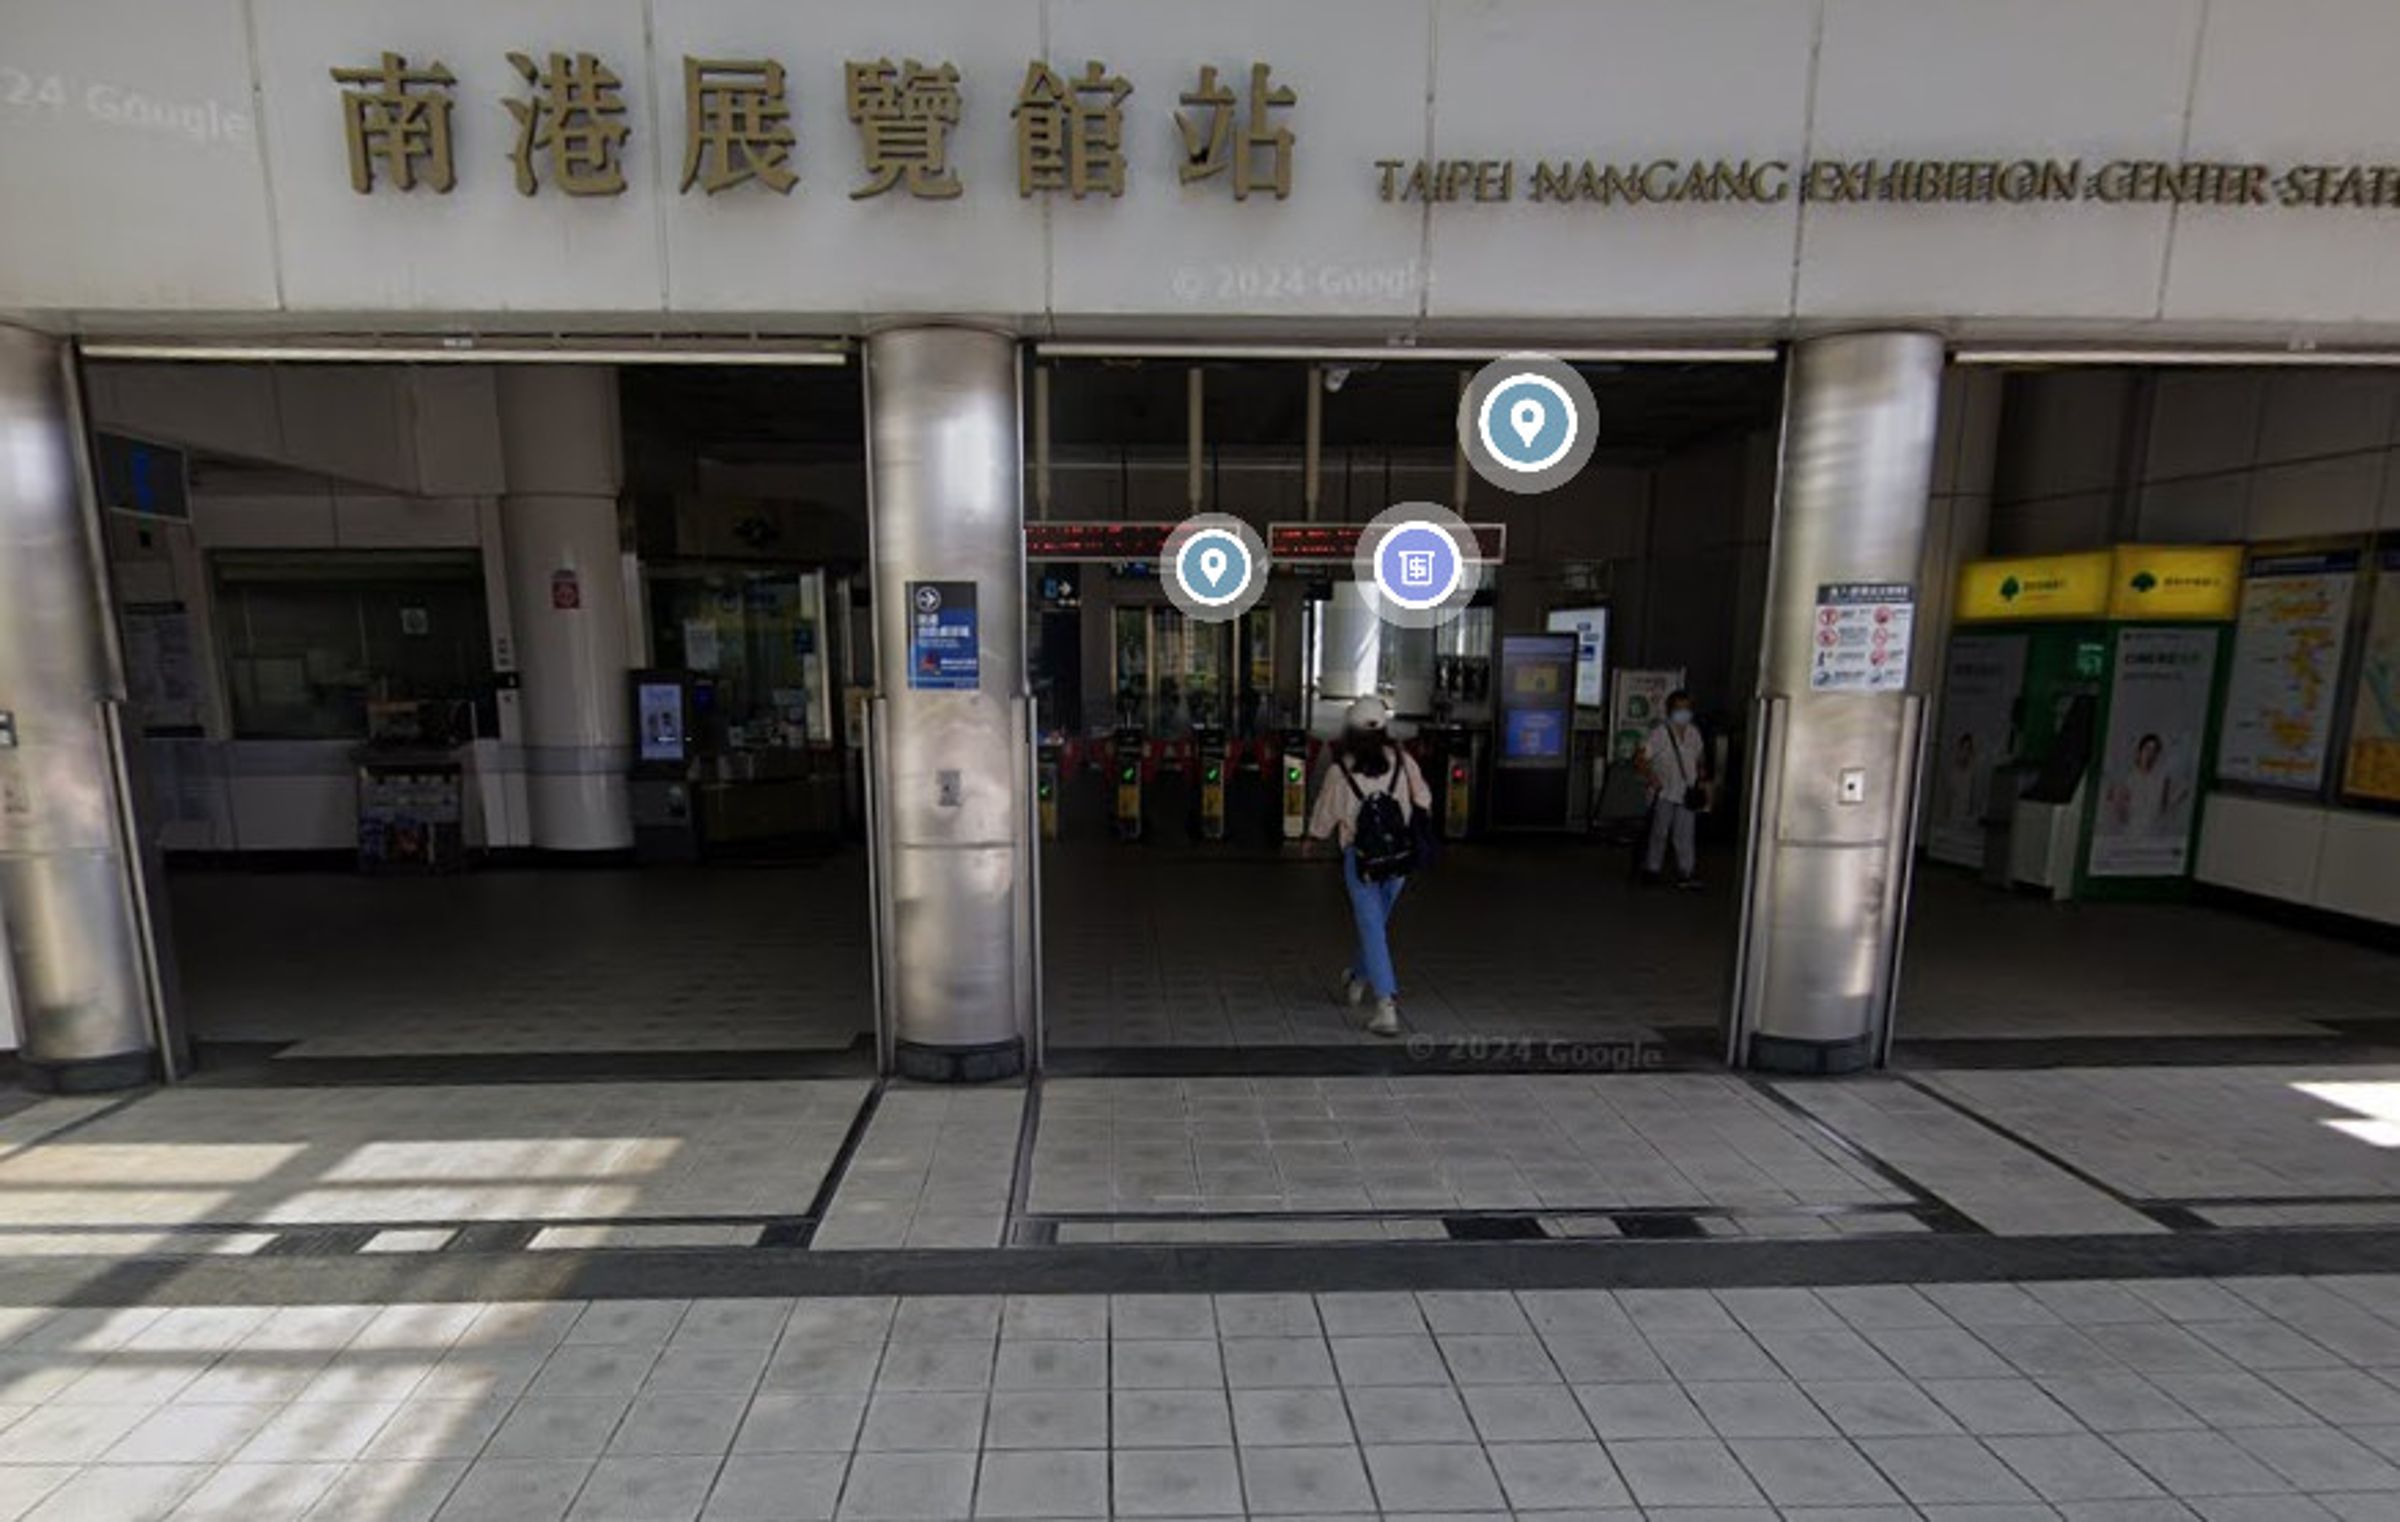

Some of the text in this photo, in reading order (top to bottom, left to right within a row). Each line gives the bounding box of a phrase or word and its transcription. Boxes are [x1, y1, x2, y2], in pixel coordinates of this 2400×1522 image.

[330, 52, 1298, 202] 南港展覽館站
[1375, 160, 1514, 204] TAIPEI
[1529, 159, 1789, 206] NANGANG
[1804, 159, 2082, 205] EXHIBITION
[2085, 160, 2272, 206] CENTER
